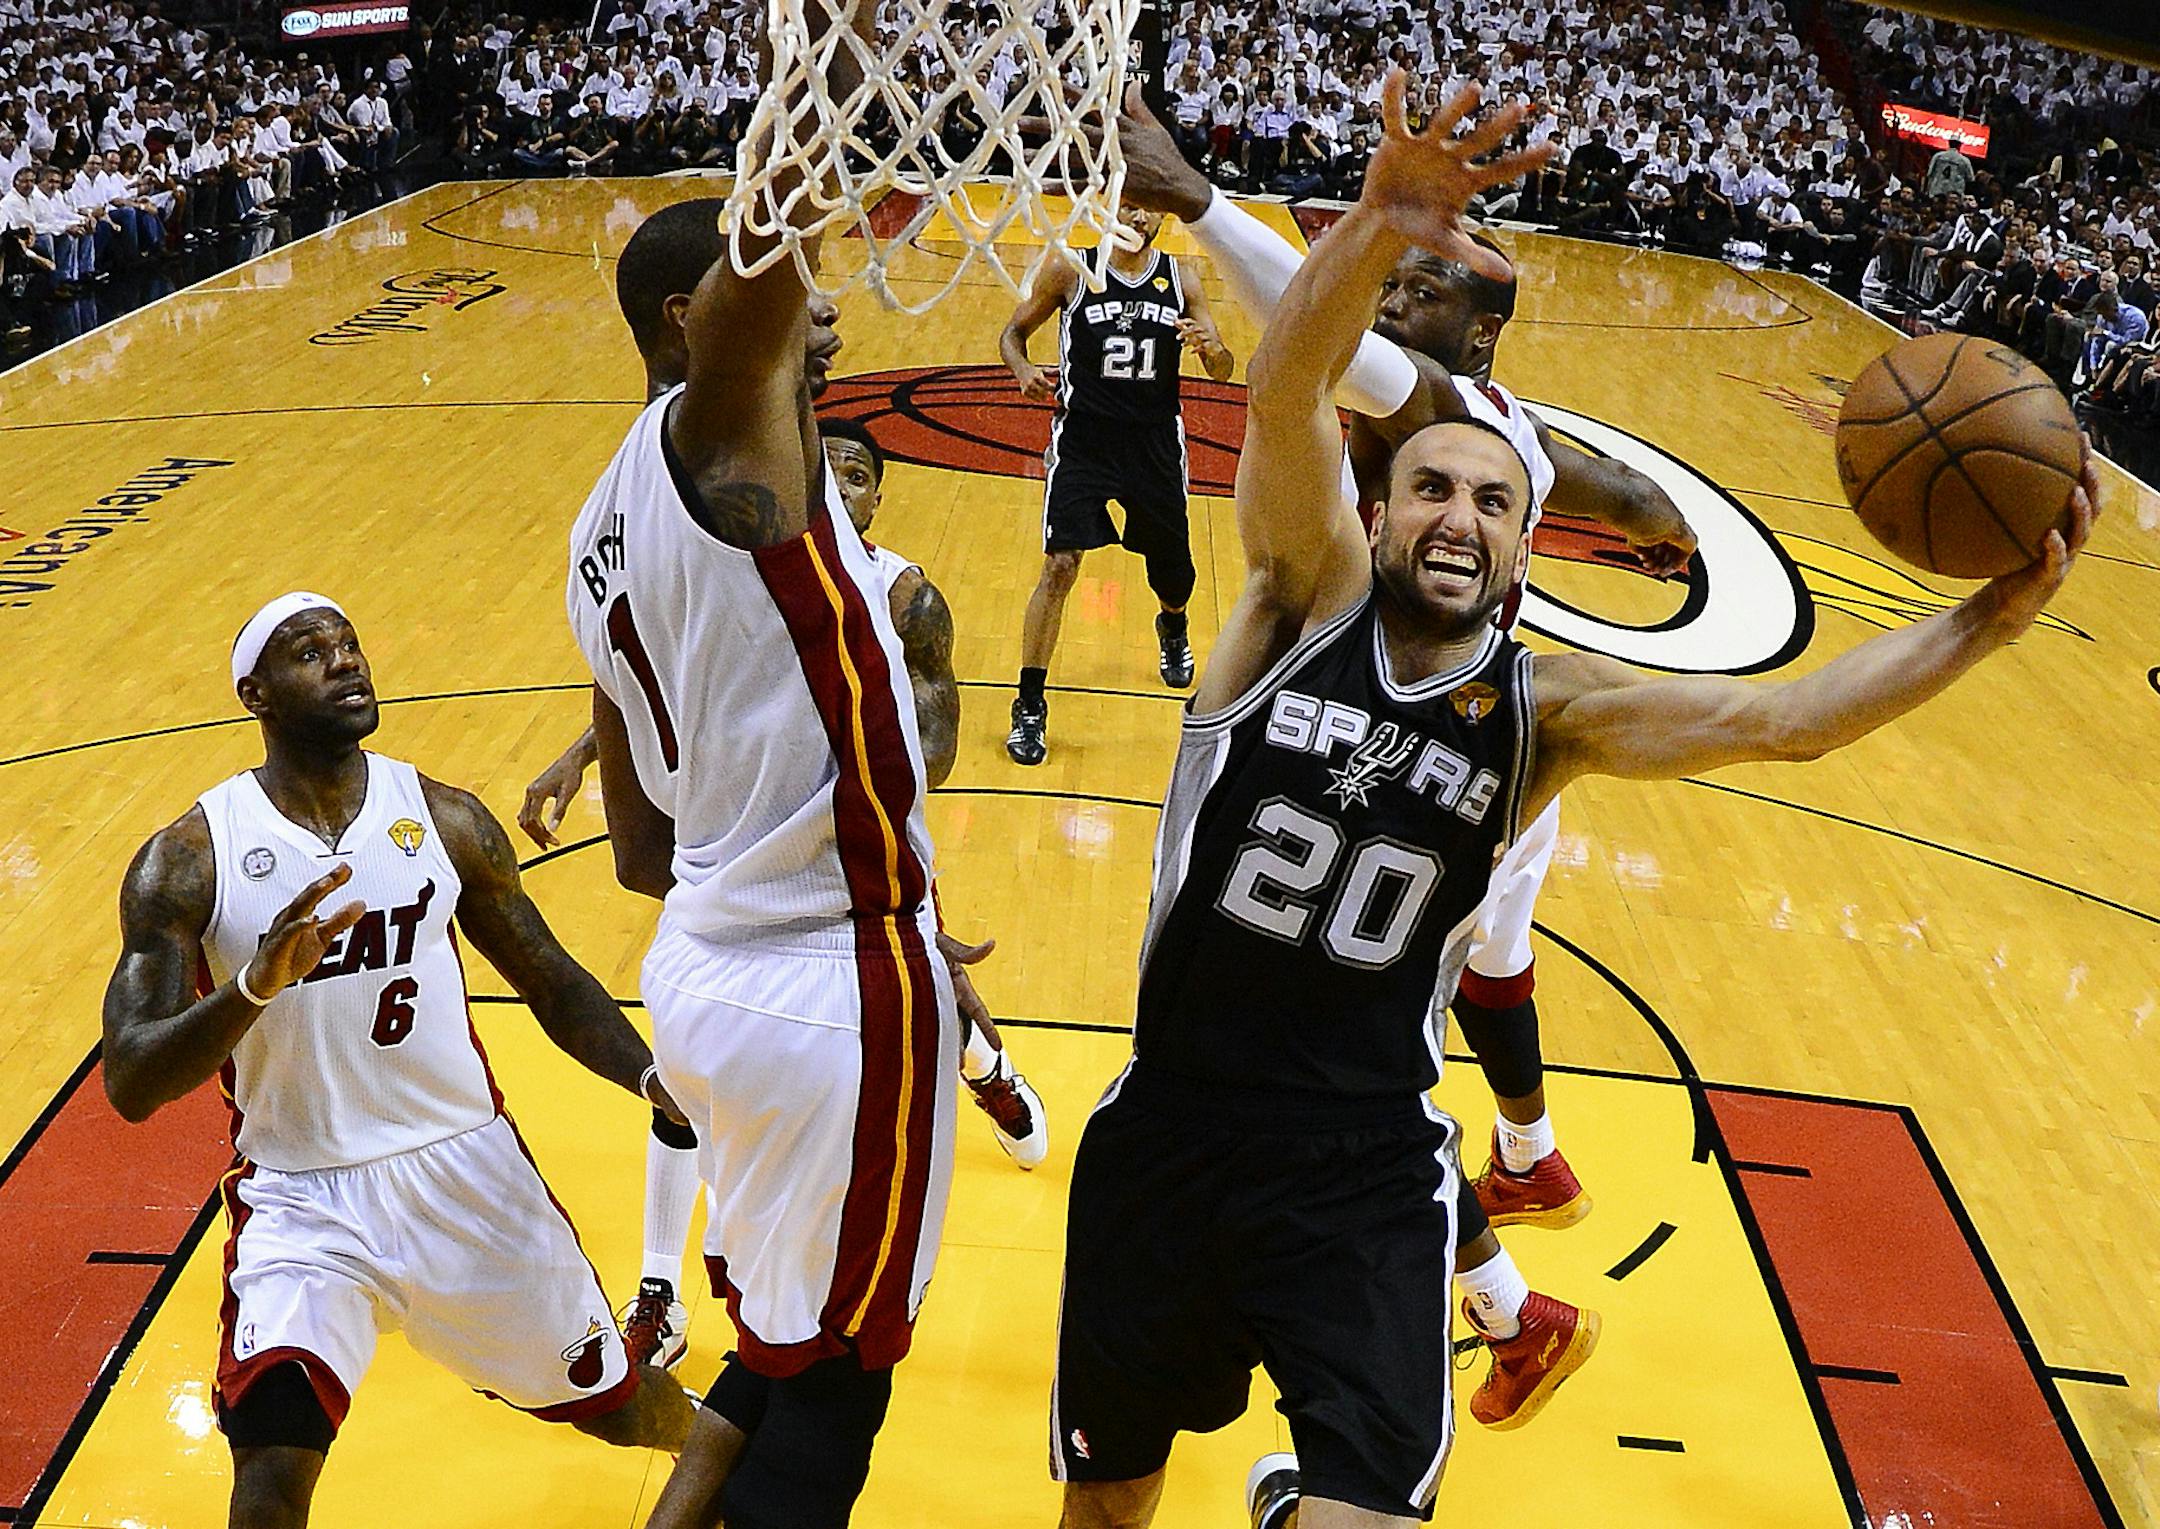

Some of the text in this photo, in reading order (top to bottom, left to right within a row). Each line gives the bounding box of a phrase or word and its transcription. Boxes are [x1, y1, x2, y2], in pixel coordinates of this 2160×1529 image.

[321, 11, 351, 28] SUN
[352, 7, 409, 26] SPORTS
[1881, 109, 1986, 147] Budweiser
[1084, 301, 1180, 332] SPURS
[1101, 336, 1157, 380] 21
[604, 588, 682, 777] 1
[1266, 690, 1501, 825] SPURS
[1214, 794, 1446, 971] 20
[257, 878, 436, 988] EAT
[369, 975, 420, 1048] 6
